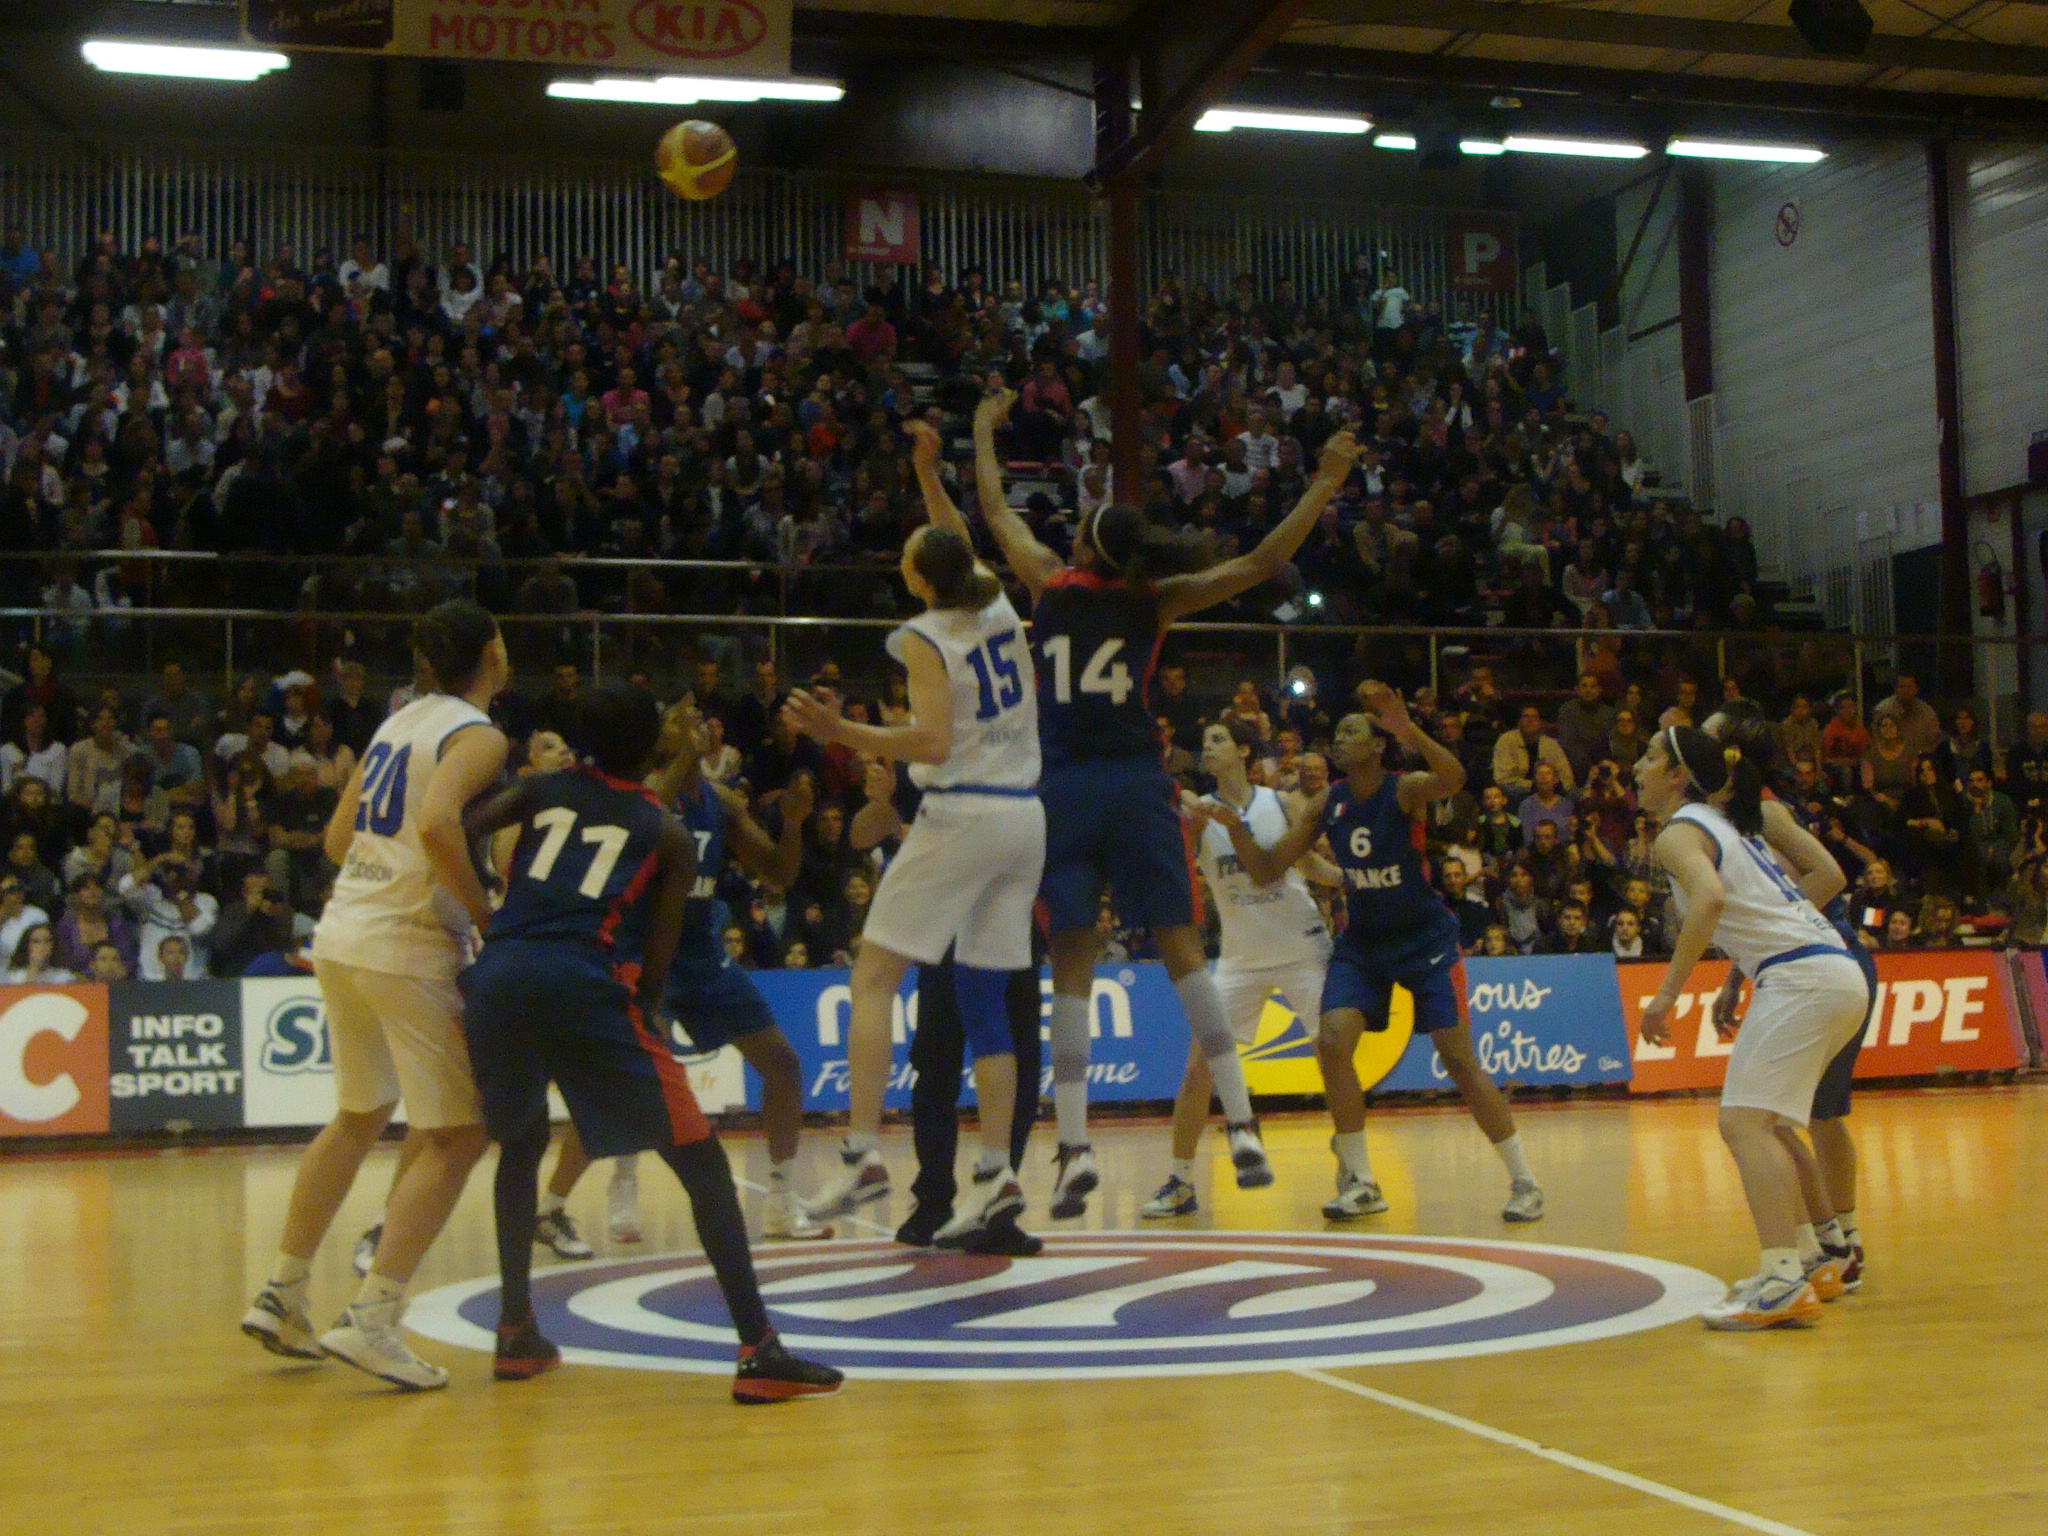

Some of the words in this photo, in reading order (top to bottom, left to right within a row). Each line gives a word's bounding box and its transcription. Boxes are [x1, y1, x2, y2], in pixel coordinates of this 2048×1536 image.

[429, 14, 616, 60] MOTORS
[654, 3, 744, 43] KIA
[860, 200, 904, 245] N
[1464, 232, 1500, 273] P
[966, 628, 1023, 721] 15
[1043, 634, 1134, 706] 14
[354, 741, 413, 838] 20
[1350, 826, 1373, 859] 6
[130, 1013, 224, 1039] INFO
[127, 1042, 228, 1068] TALK
[110, 1069, 242, 1098] SPORT
